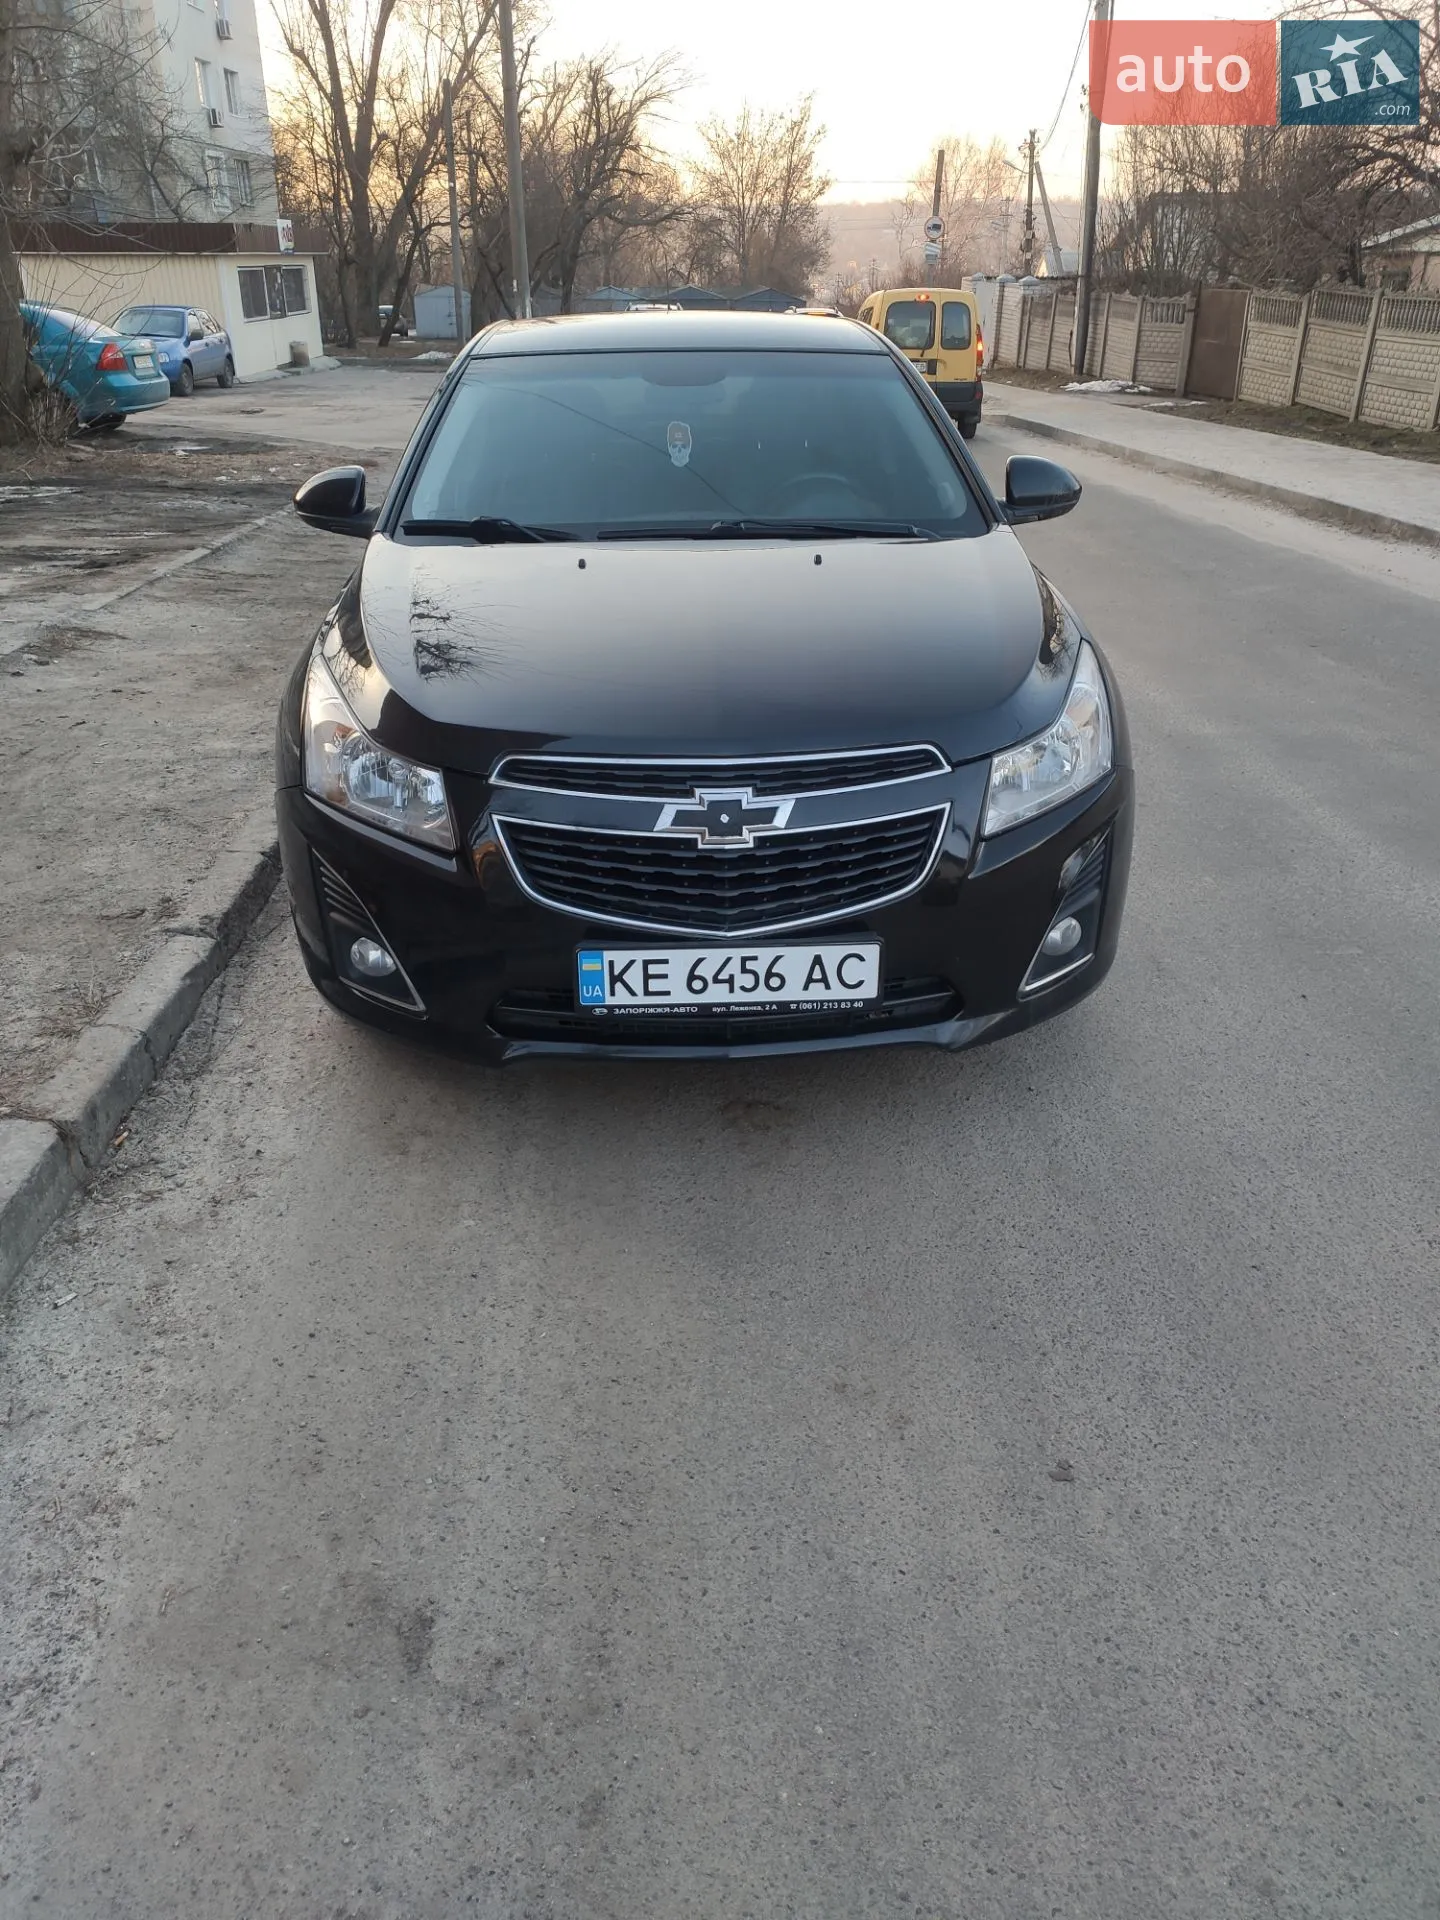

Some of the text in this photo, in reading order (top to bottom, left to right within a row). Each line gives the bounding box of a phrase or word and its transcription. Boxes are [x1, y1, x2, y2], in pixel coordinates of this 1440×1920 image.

[608, 952, 866, 997] KE 6456 AC
[583, 985, 602, 997] UA
[799, 1001, 820, 1010] (061)
[823, 1001, 838, 1009] 213
[852, 1000, 863, 1008] 40
